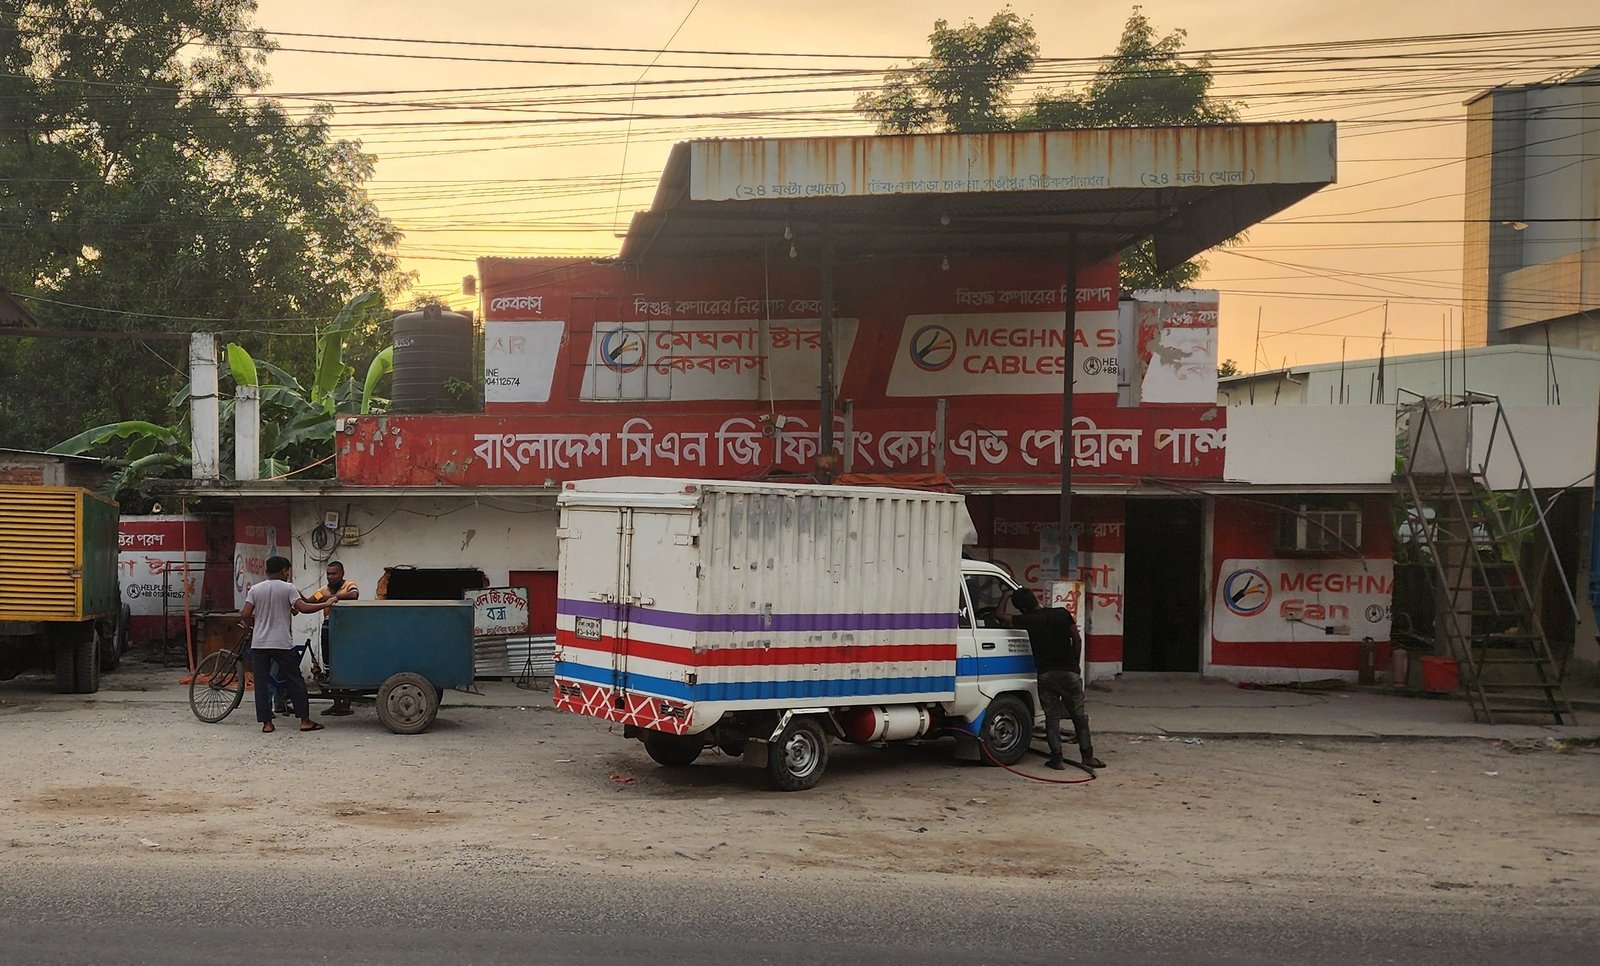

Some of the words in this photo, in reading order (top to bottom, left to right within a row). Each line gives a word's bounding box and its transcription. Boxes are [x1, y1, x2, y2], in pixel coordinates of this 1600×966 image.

[655, 327, 759, 350] মেঘনা
[965, 328, 1089, 348] MEGHNA
[655, 355, 769, 381] কেবলস্
[473, 433, 611, 472] বাংলাদেশ
[715, 418, 763, 467] জি
